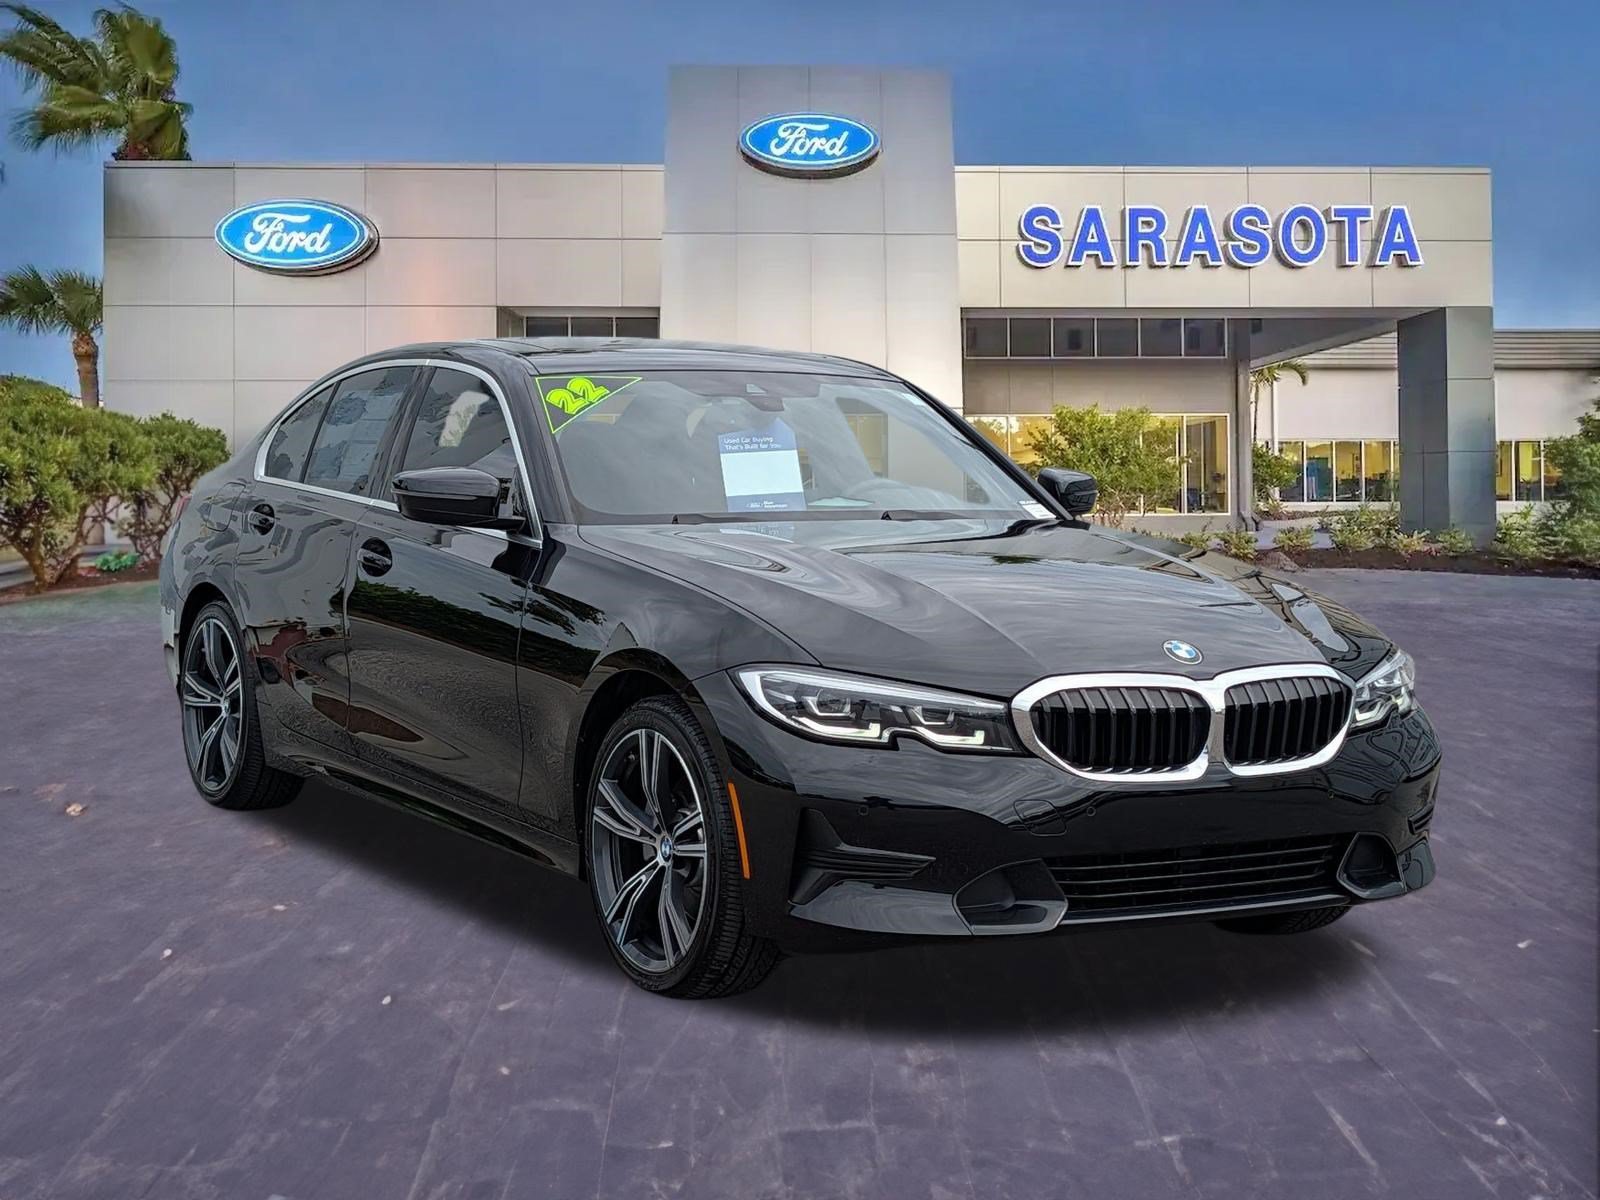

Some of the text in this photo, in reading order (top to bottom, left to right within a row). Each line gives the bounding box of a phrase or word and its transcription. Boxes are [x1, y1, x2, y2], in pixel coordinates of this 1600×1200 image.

[770, 122, 849, 156] Ford
[244, 212, 333, 253] Ford
[1018, 204, 1424, 267] SARASOTA
[546, 377, 610, 415] 22
